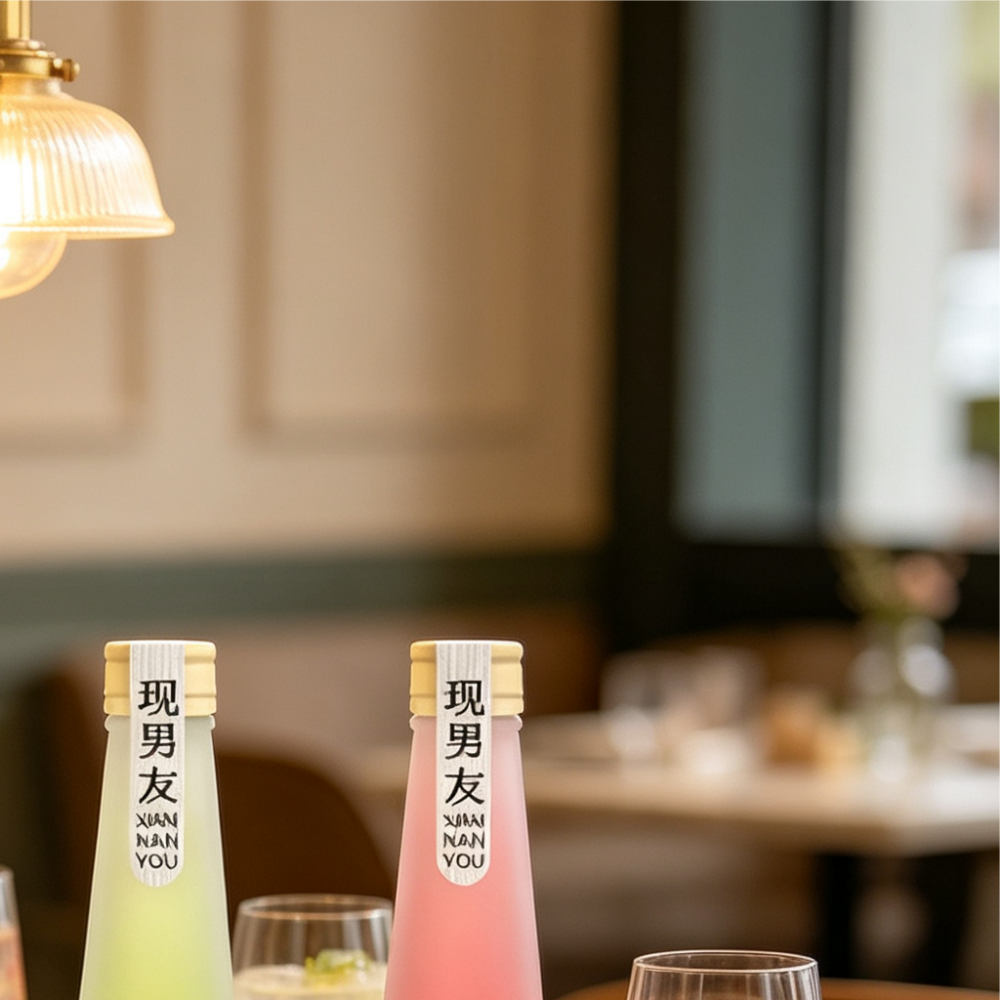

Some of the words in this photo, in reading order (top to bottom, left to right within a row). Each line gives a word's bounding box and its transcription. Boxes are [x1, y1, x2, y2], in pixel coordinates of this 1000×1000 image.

[137, 679, 180, 806] 现男友
[443, 679, 486, 806] 现男友
[135, 853, 178, 870] YOU
[442, 853, 485, 870] YOU
